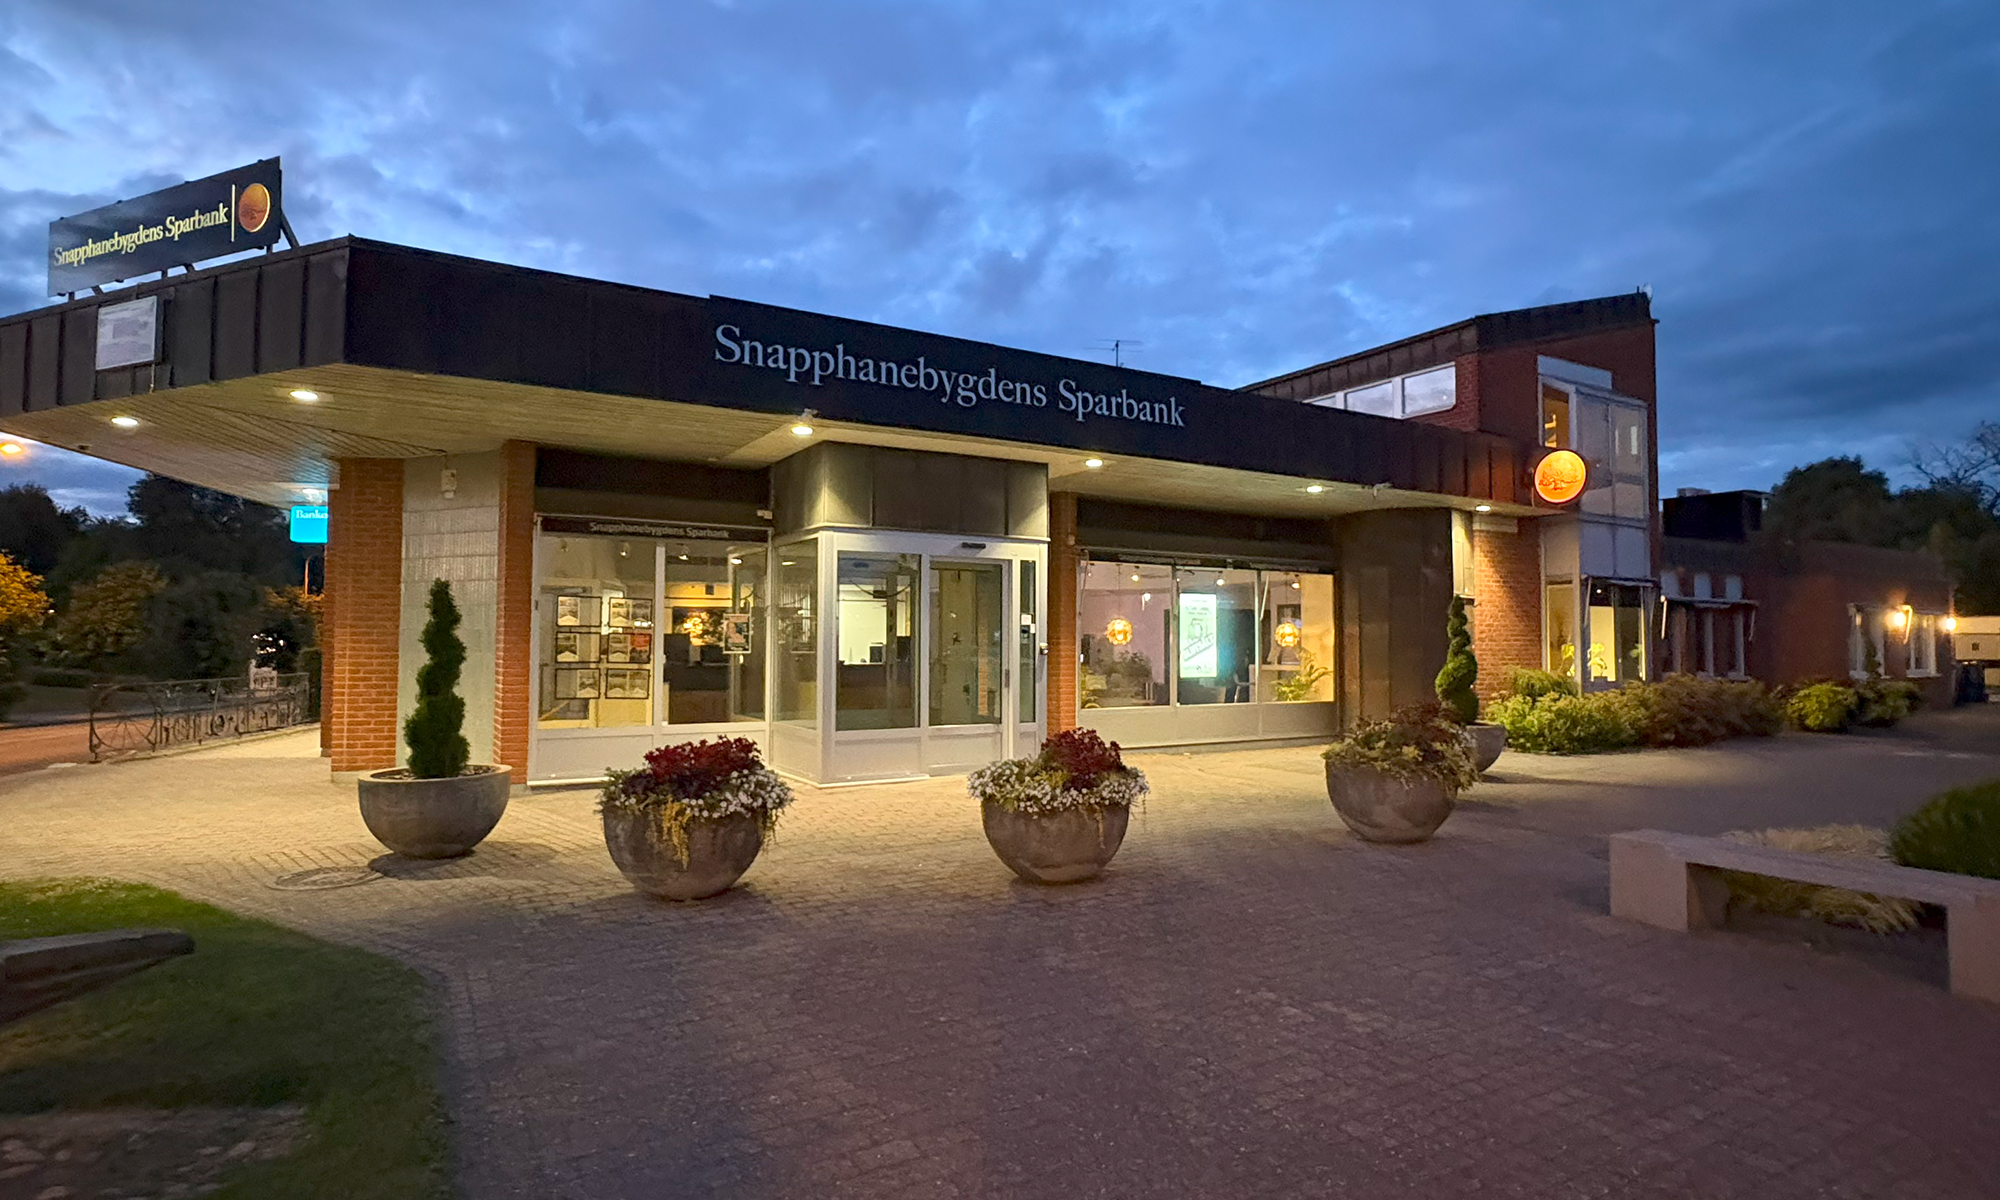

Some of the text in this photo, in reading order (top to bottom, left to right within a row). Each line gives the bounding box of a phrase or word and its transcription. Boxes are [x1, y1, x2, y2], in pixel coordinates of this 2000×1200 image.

[54, 203, 228, 267] Snapphanebygdens Sparbank
[715, 324, 1186, 427] Snapphanebygdens Sparbank
[589, 522, 729, 538] Snapphanebygdens Sparbank
